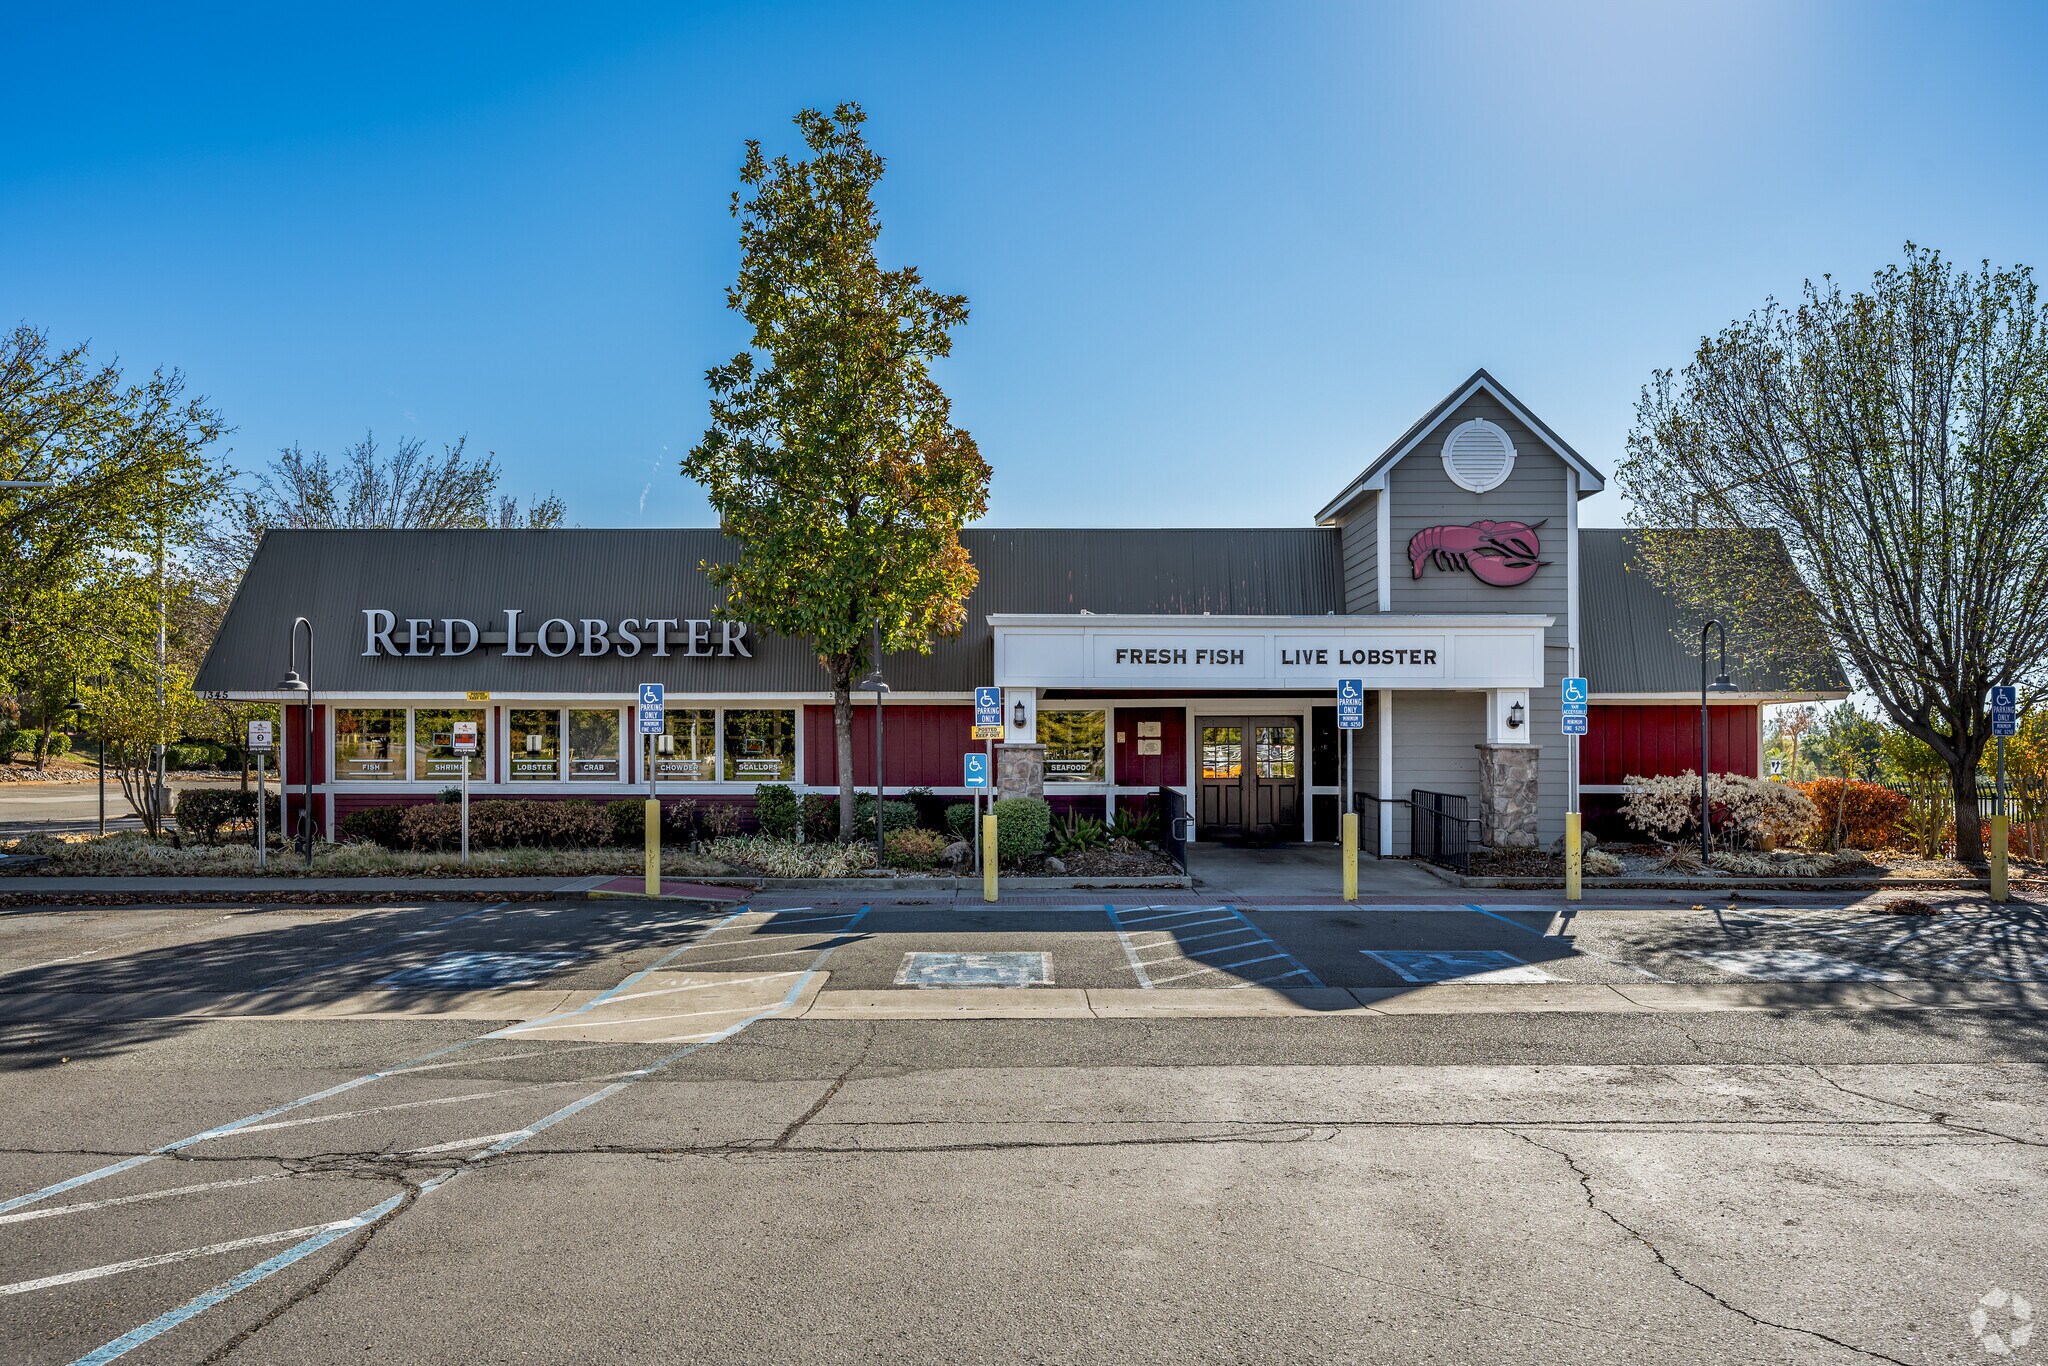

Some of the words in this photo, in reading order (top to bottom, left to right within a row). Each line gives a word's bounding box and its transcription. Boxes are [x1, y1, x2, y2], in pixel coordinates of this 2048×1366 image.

[361, 609, 479, 657] RED
[501, 609, 752, 658] LOBSTER
[1115, 648, 1187, 665] FRESH
[1195, 648, 1244, 665] FISH
[1281, 648, 1328, 665] LIVE
[1339, 648, 1437, 665] LOBSTER
[203, 691, 229, 699] 1345
[1340, 698, 1362, 706] PARKING
[641, 703, 663, 711] PARKING
[977, 707, 1000, 715] PARKING
[1344, 706, 1357, 714] ONLY
[1993, 706, 2015, 714] PARKING
[645, 711, 658, 719] ONLY
[981, 715, 995, 723] ONLY
[1997, 713, 2010, 722] ONLY
[660, 764, 699, 772] CHOWDER
